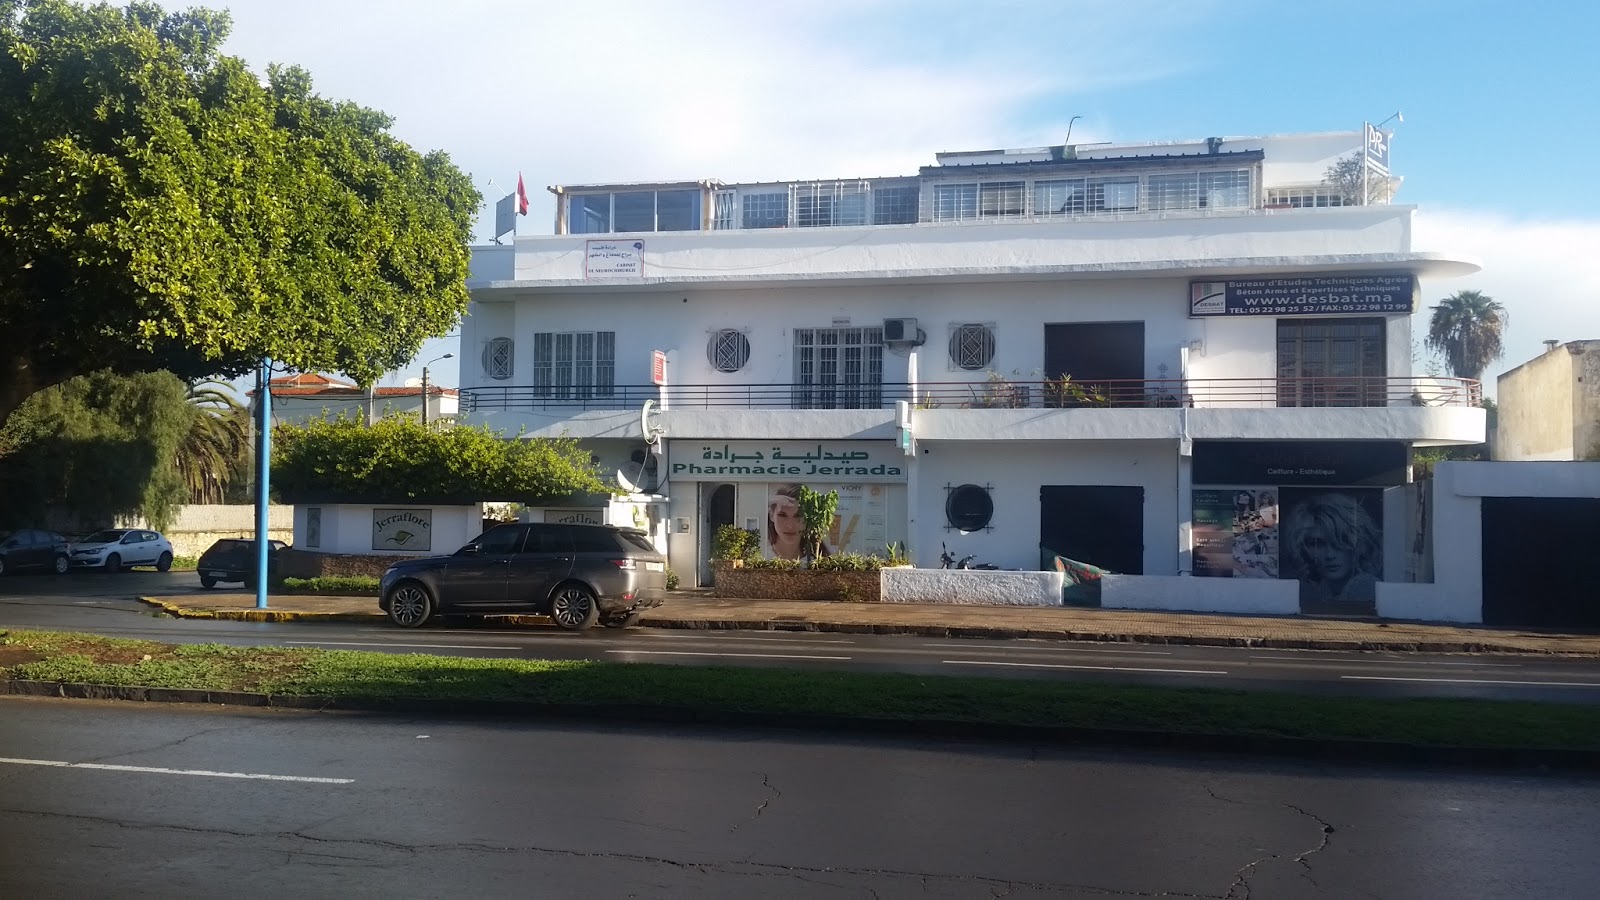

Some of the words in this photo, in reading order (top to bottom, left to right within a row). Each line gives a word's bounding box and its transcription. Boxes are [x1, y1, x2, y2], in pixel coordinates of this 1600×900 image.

[1315, 277, 1374, 285] Techniques
[1301, 286, 1348, 294] Expertises
[1350, 285, 1401, 293] Techniques
[1244, 293, 1392, 306] www.desbat.ma
[702, 445, 765, 464] جرادة
[772, 445, 869, 464] صيدلية
[672, 463, 801, 475] Pharmacie
[805, 464, 901, 476] Jerrada
[375, 512, 430, 532] Jerraflore
